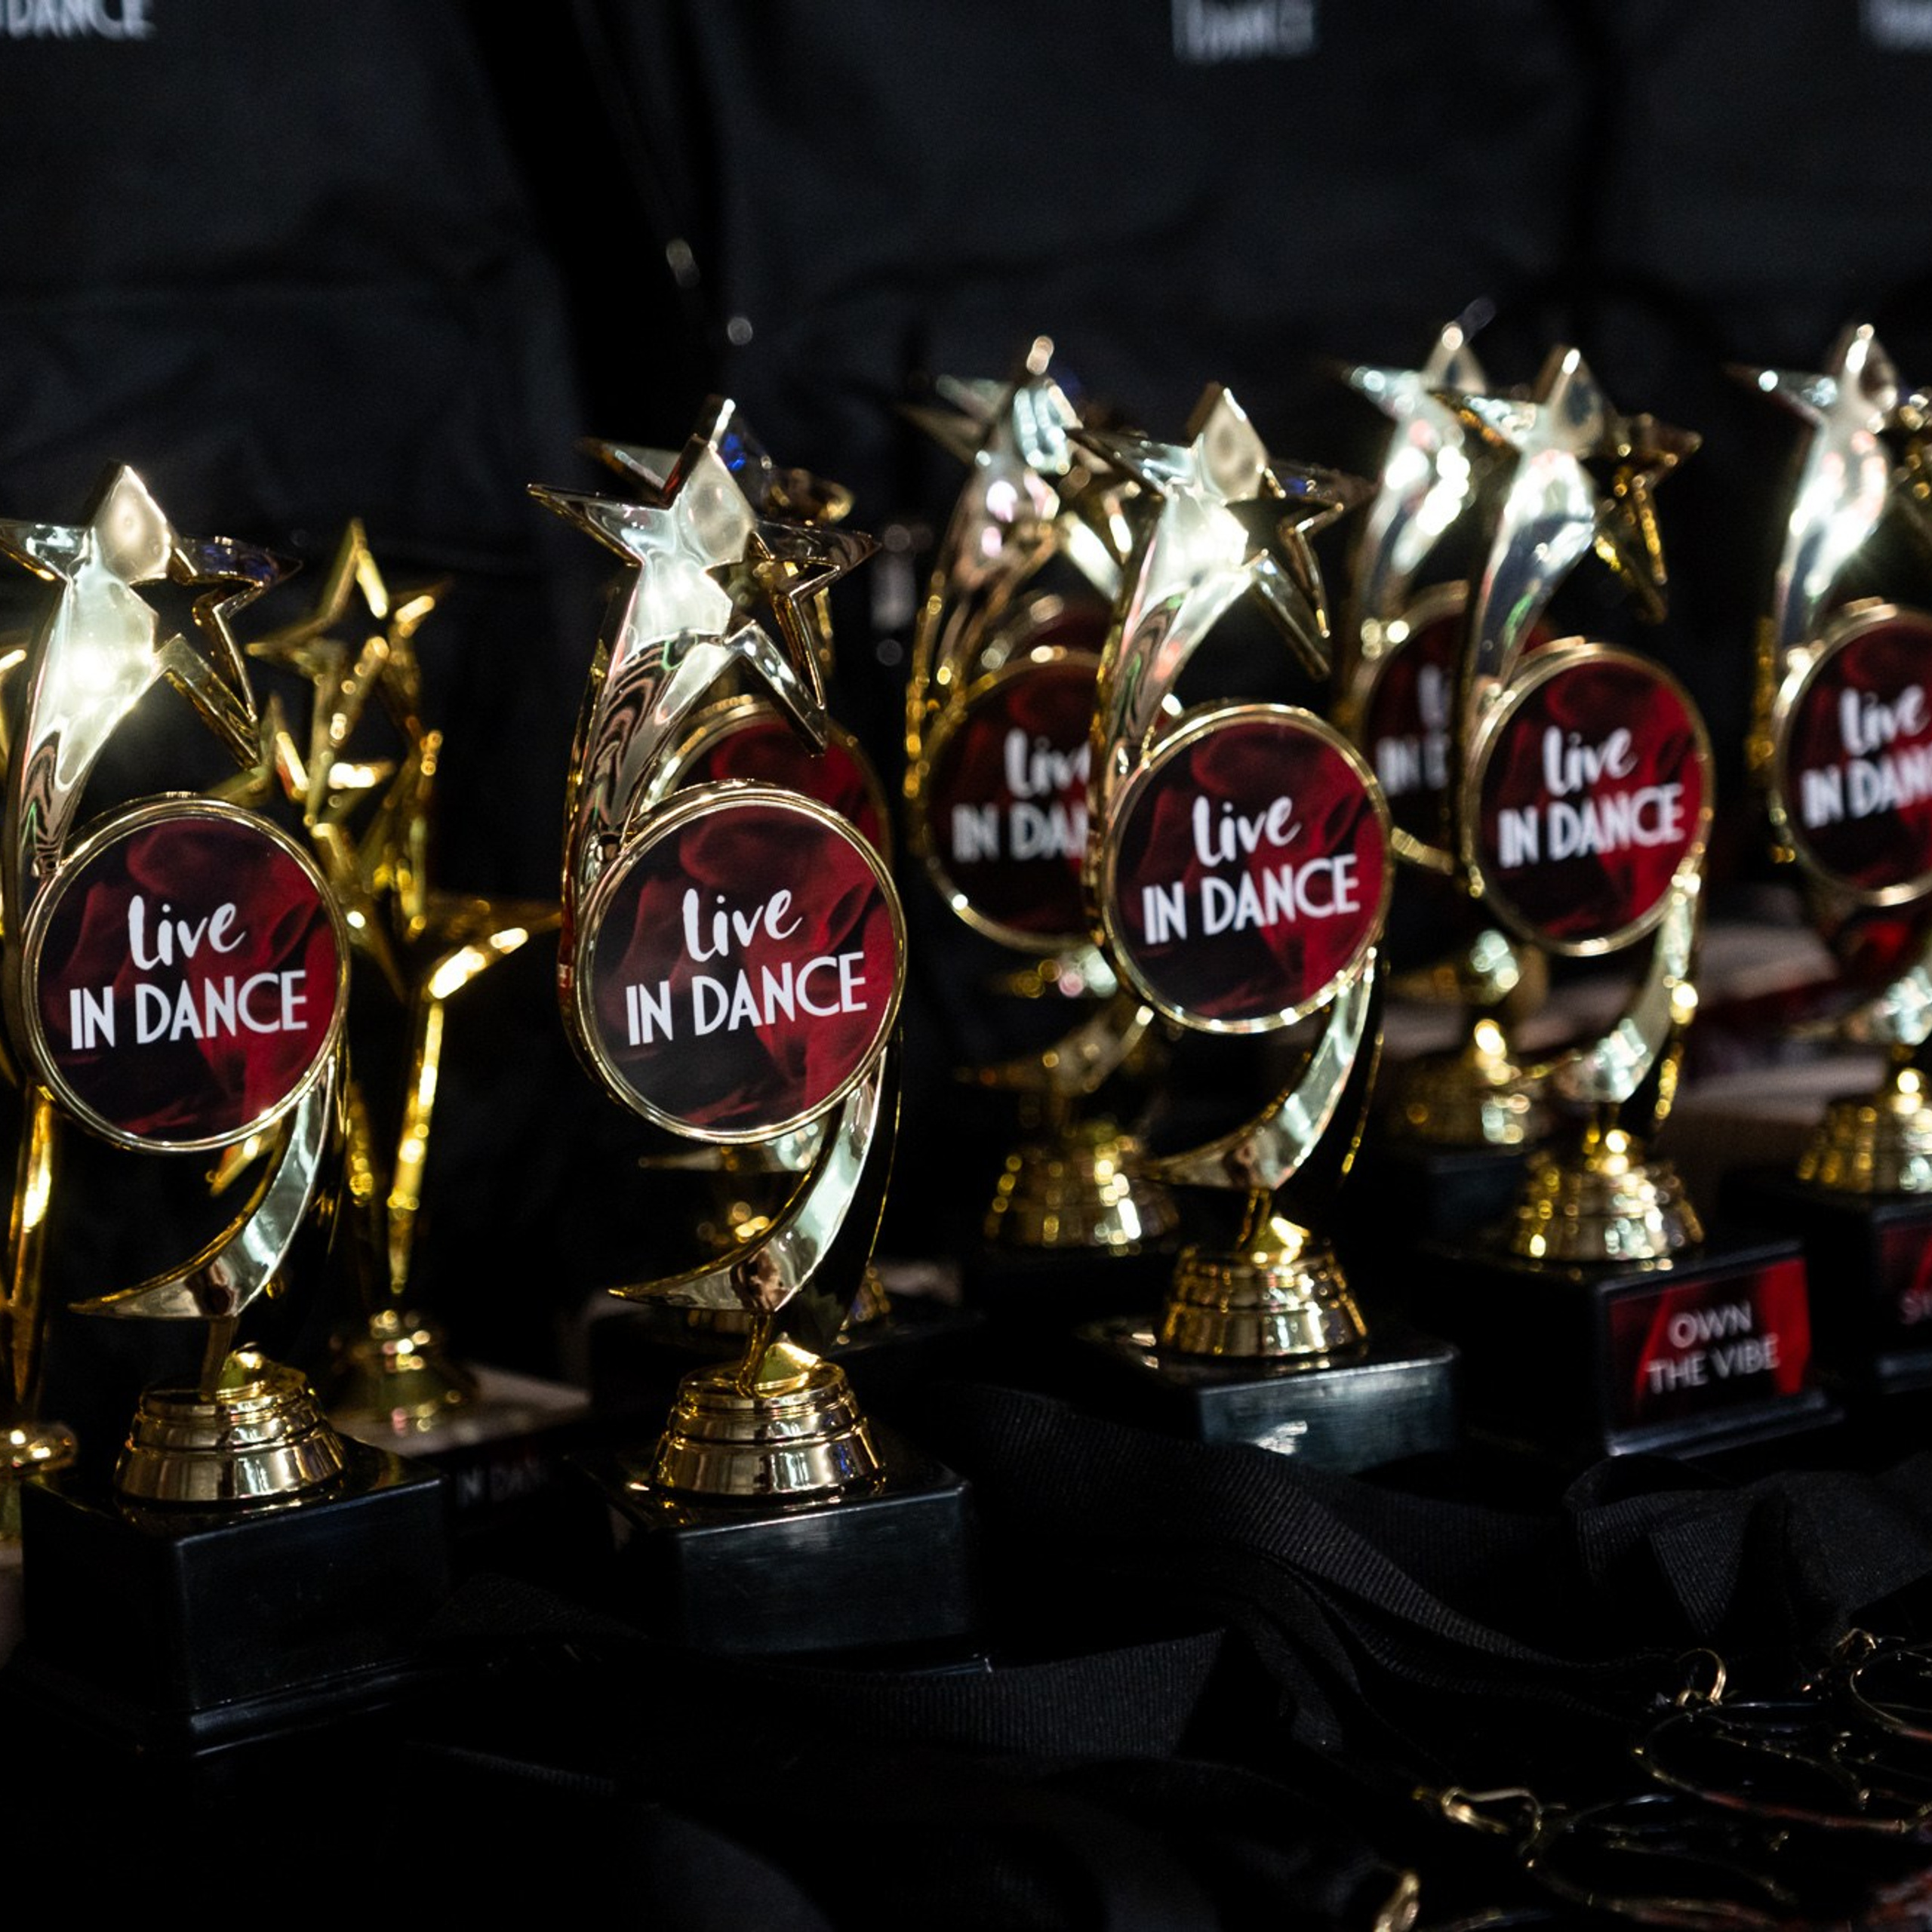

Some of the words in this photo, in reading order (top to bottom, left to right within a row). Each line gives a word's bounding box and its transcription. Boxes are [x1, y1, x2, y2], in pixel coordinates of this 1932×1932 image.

[1543, 726, 1638, 797] Live
[1800, 764, 1842, 828] IN
[952, 803, 1000, 863] IN
[1192, 795, 1303, 867] Live
[1498, 806, 1539, 867] IN
[1548, 783, 1684, 860] DANCE
[128, 894, 247, 971] Live
[682, 888, 803, 962] Live
[1142, 881, 1187, 944] IN
[1200, 854, 1360, 936] DANCE
[69, 985, 115, 1050] IN
[134, 969, 308, 1044] DANCE
[626, 980, 673, 1046] IN
[691, 951, 867, 1035] DANCE
[1668, 1301, 1752, 1349] OWN
[1645, 1351, 1709, 1395] THE
[1709, 1332, 1781, 1380] VIBE
